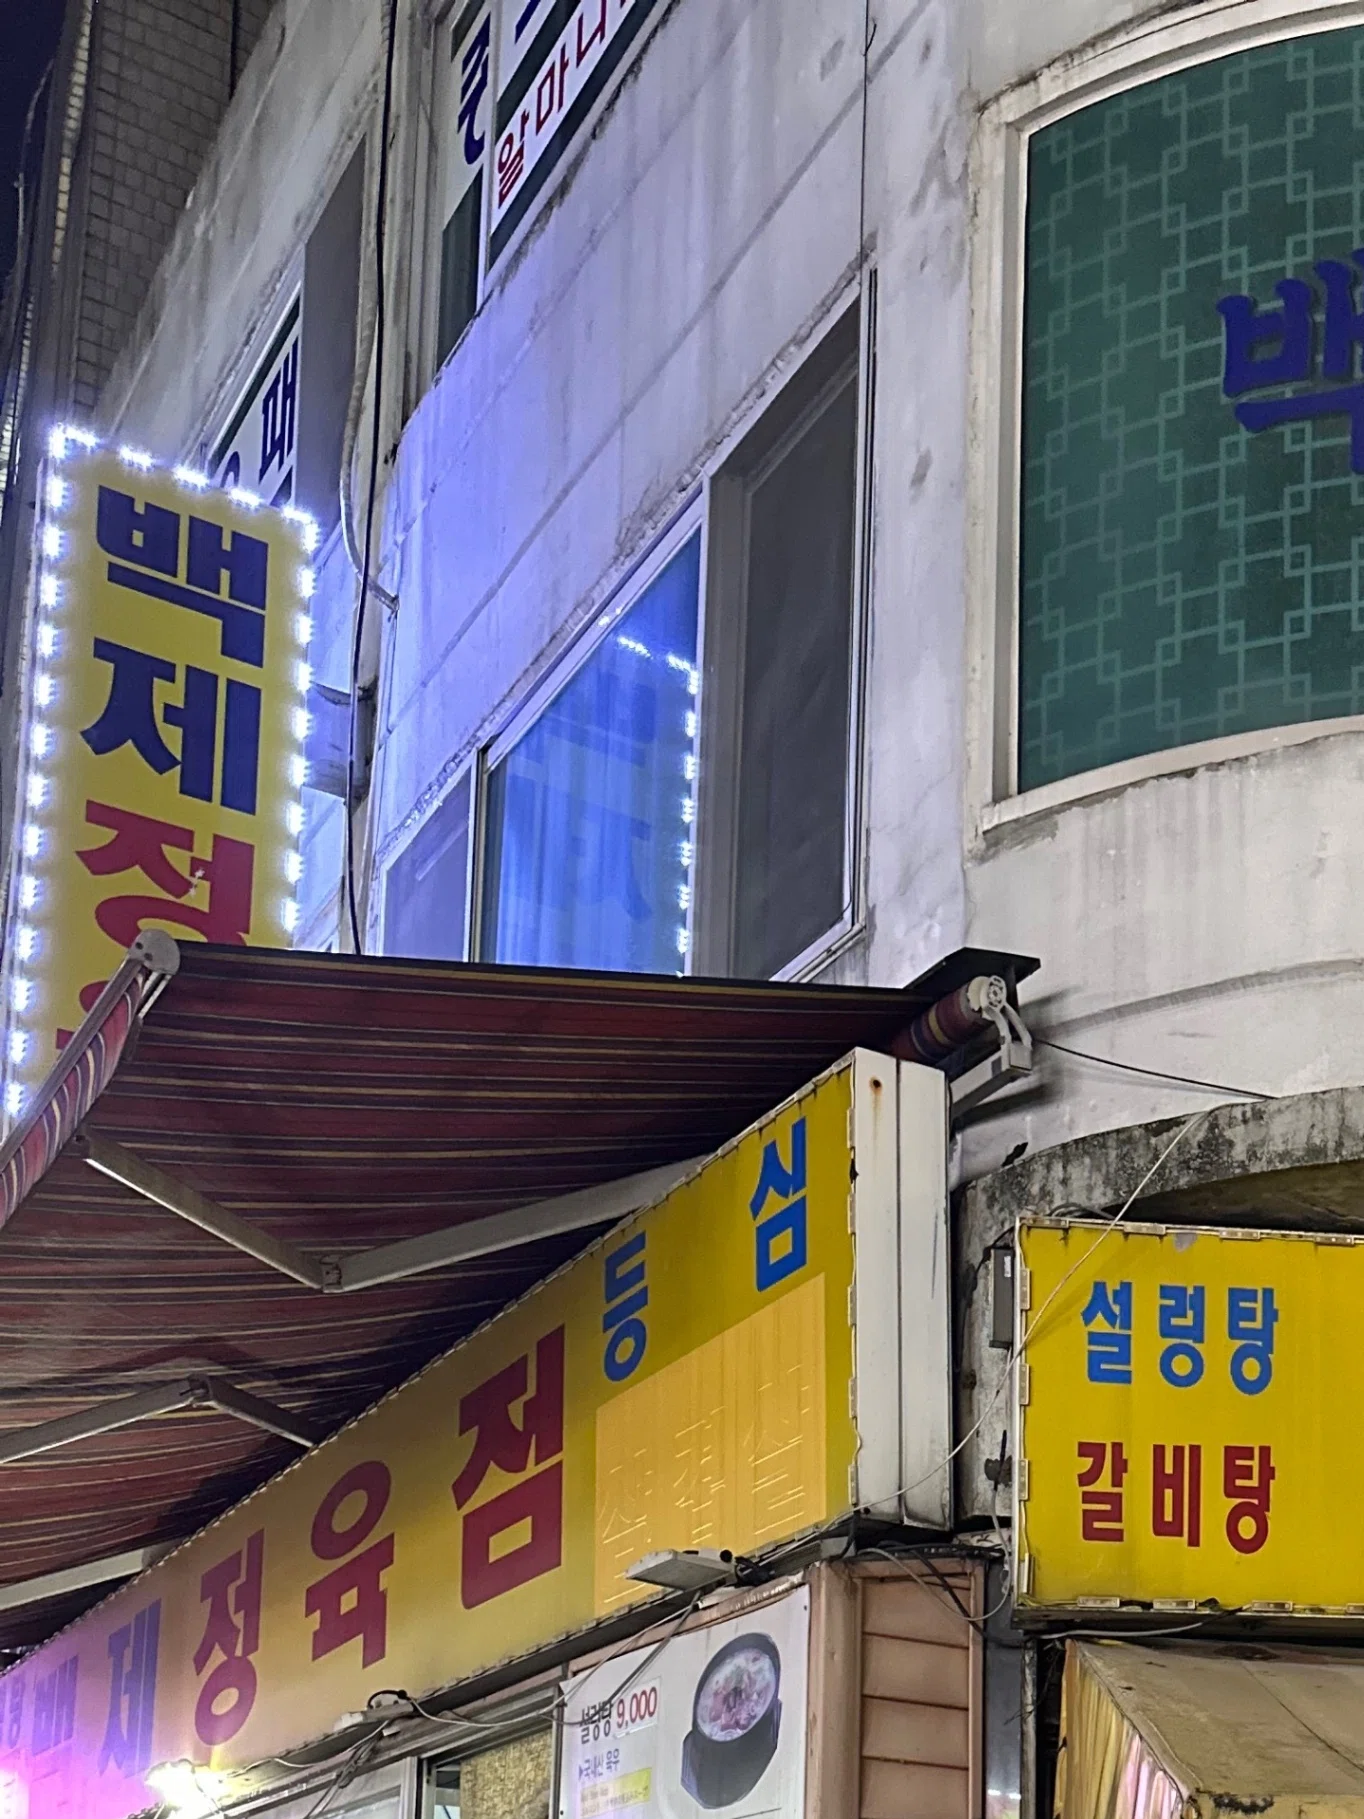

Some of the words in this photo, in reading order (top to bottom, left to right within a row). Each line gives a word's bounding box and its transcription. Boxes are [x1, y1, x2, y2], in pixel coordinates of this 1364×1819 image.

[56, 485, 270, 1056] 백제정
[1081, 1280, 1279, 1395] 설렁탕
[1076, 1441, 1276, 1554] 갈비탕
[616, 1686, 657, 1729] 9,000
